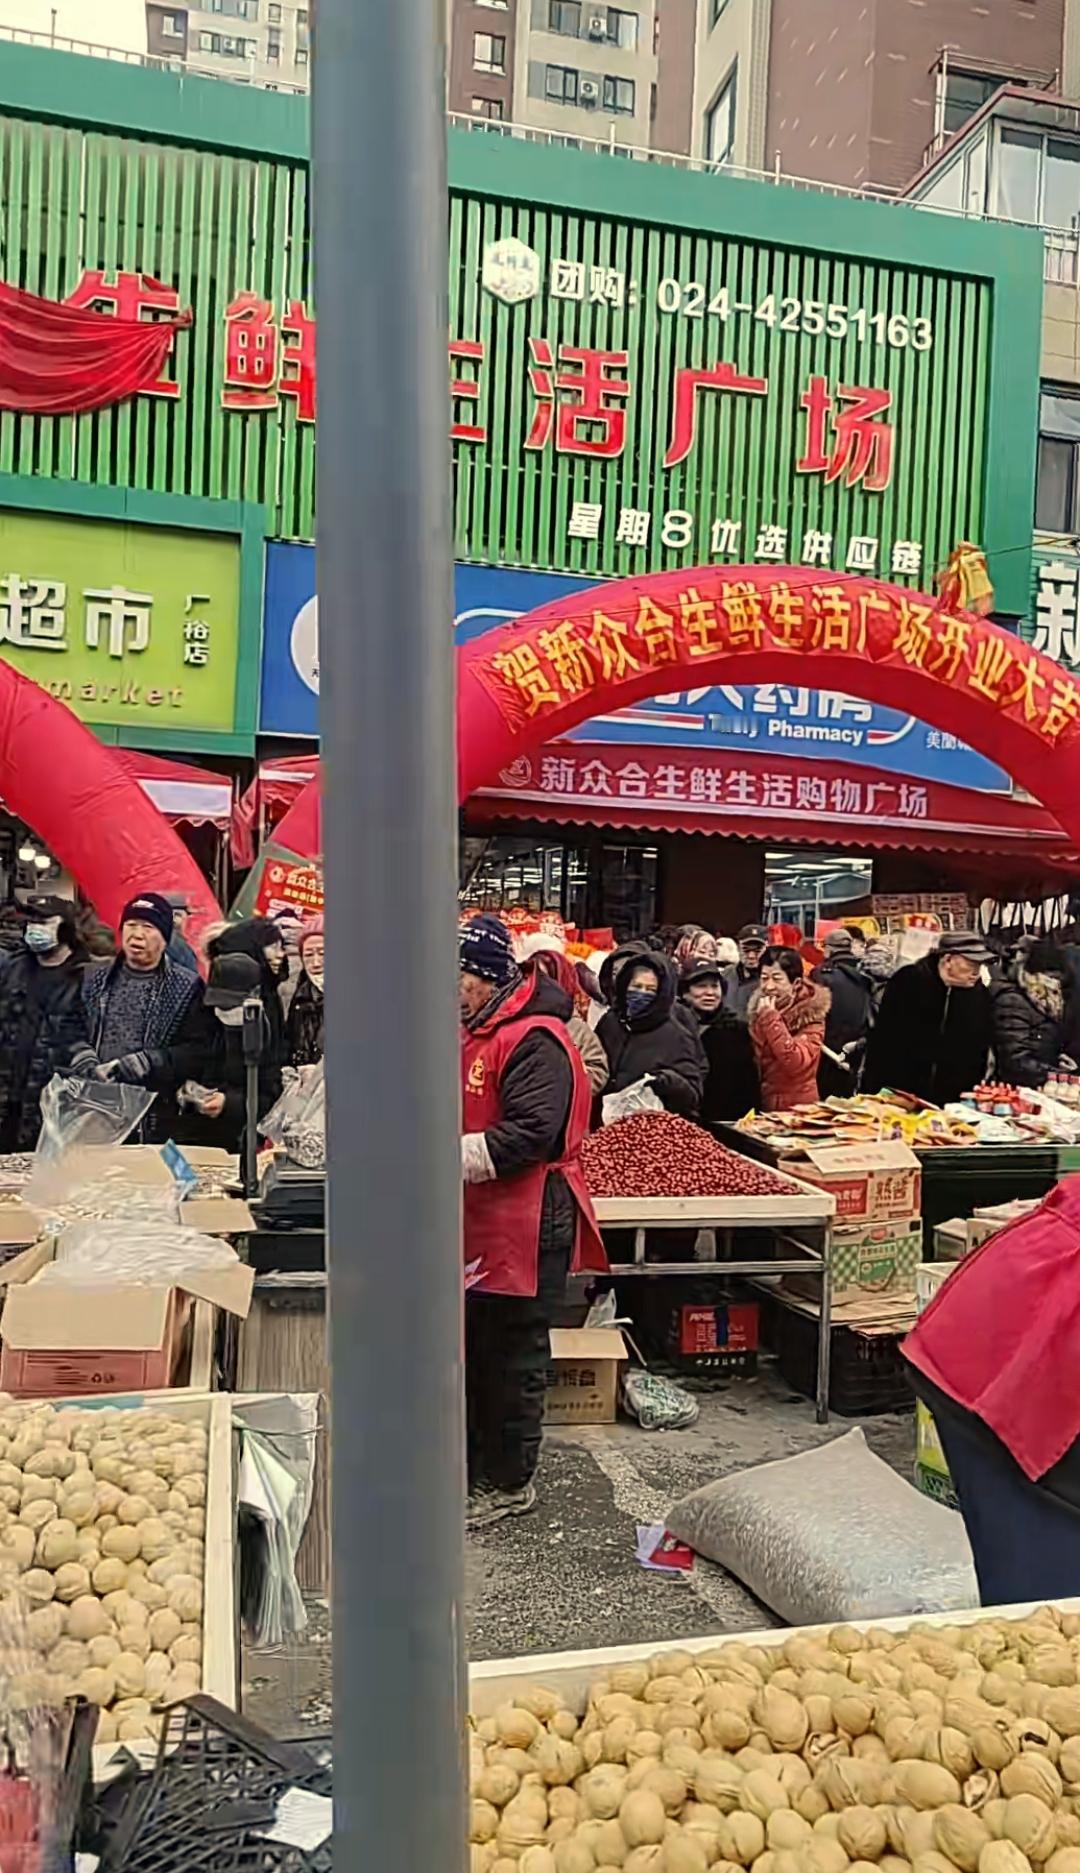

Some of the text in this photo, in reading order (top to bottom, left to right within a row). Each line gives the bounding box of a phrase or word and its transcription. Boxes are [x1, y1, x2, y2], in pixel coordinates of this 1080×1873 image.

[656, 277, 934, 352] 024-42551163
[567, 501, 924, 576] 星期8优选供应链
[0, 573, 153, 658] 超市
[492, 580, 1080, 736] 贺新众合生鲜生活广场开业大吉
[768, 719, 863, 747] Pharmacy
[540, 756, 928, 818] 新众合生鲜生活购物广场
